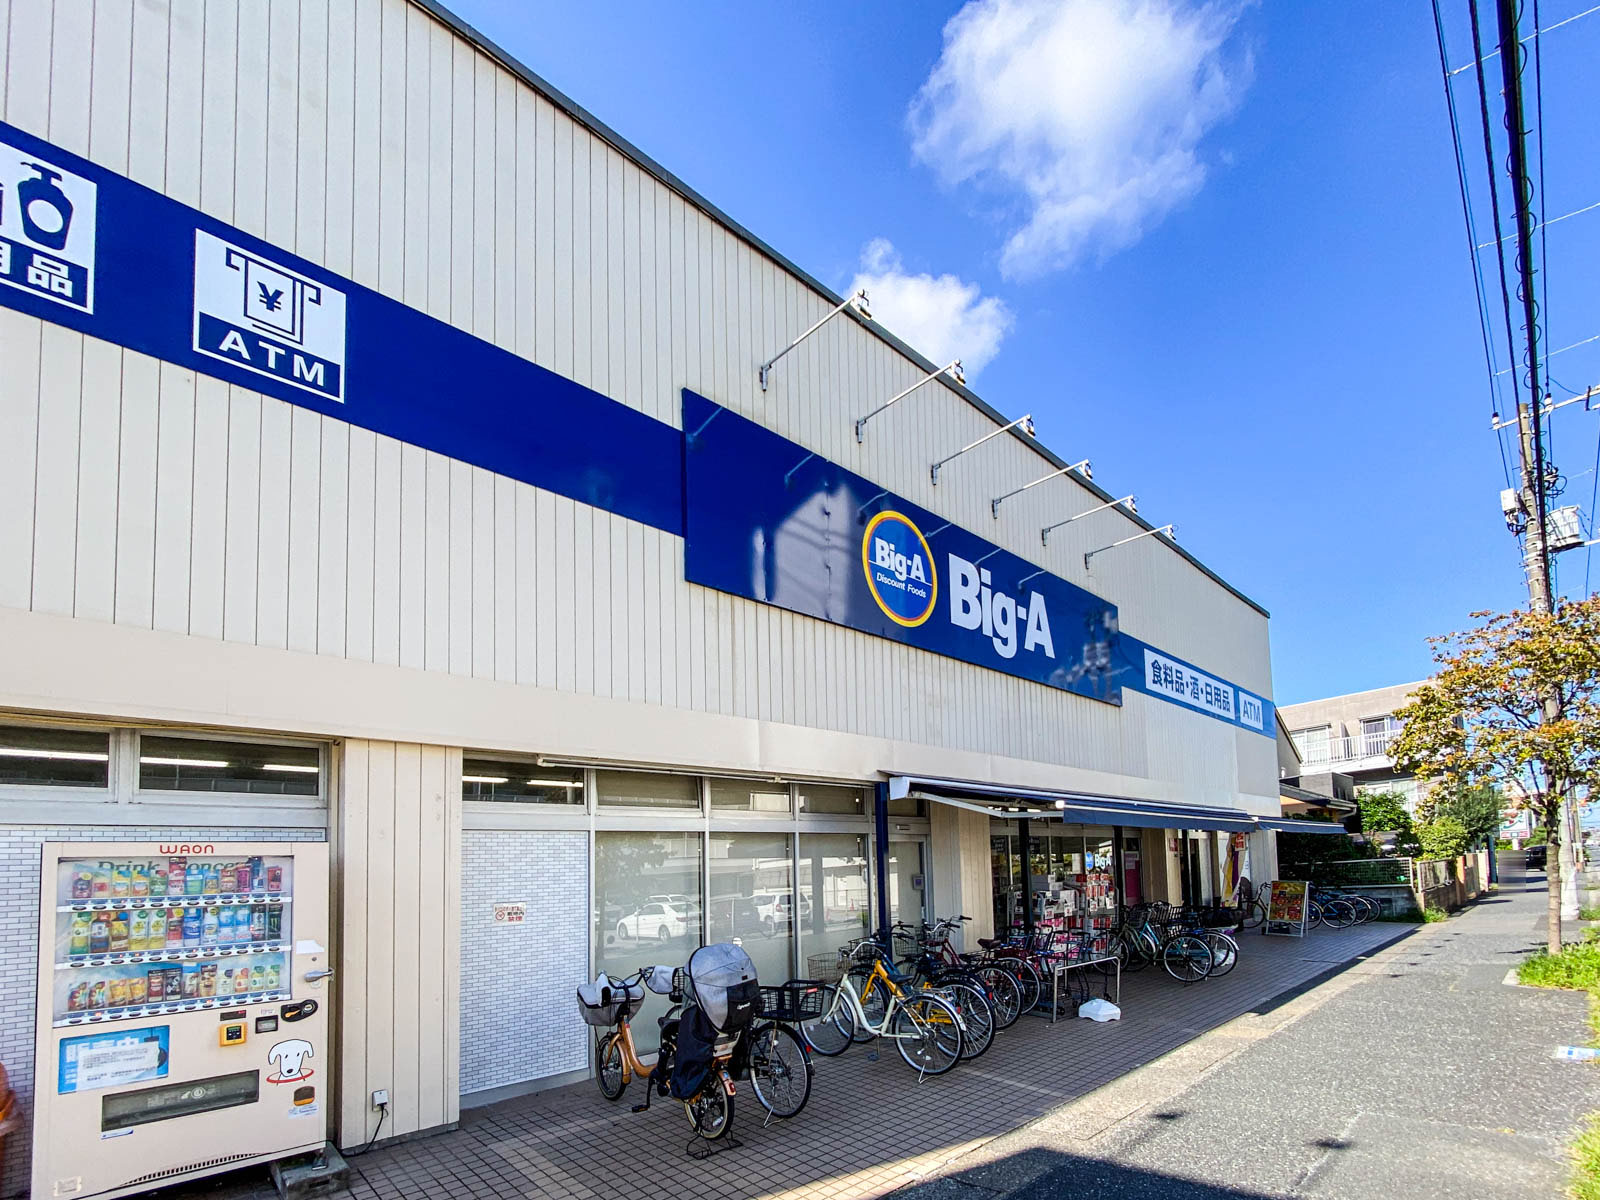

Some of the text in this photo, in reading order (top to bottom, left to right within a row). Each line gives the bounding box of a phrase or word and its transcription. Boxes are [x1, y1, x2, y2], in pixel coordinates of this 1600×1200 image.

[0, 241, 73, 298] 品
[218, 330, 325, 387] ATM
[875, 537, 926, 583] Big-A
[876, 572, 926, 598] Discount Foods
[948, 552, 1056, 659] Big-A
[1242, 699, 1261, 724] ATM
[159, 844, 214, 855] WAON
